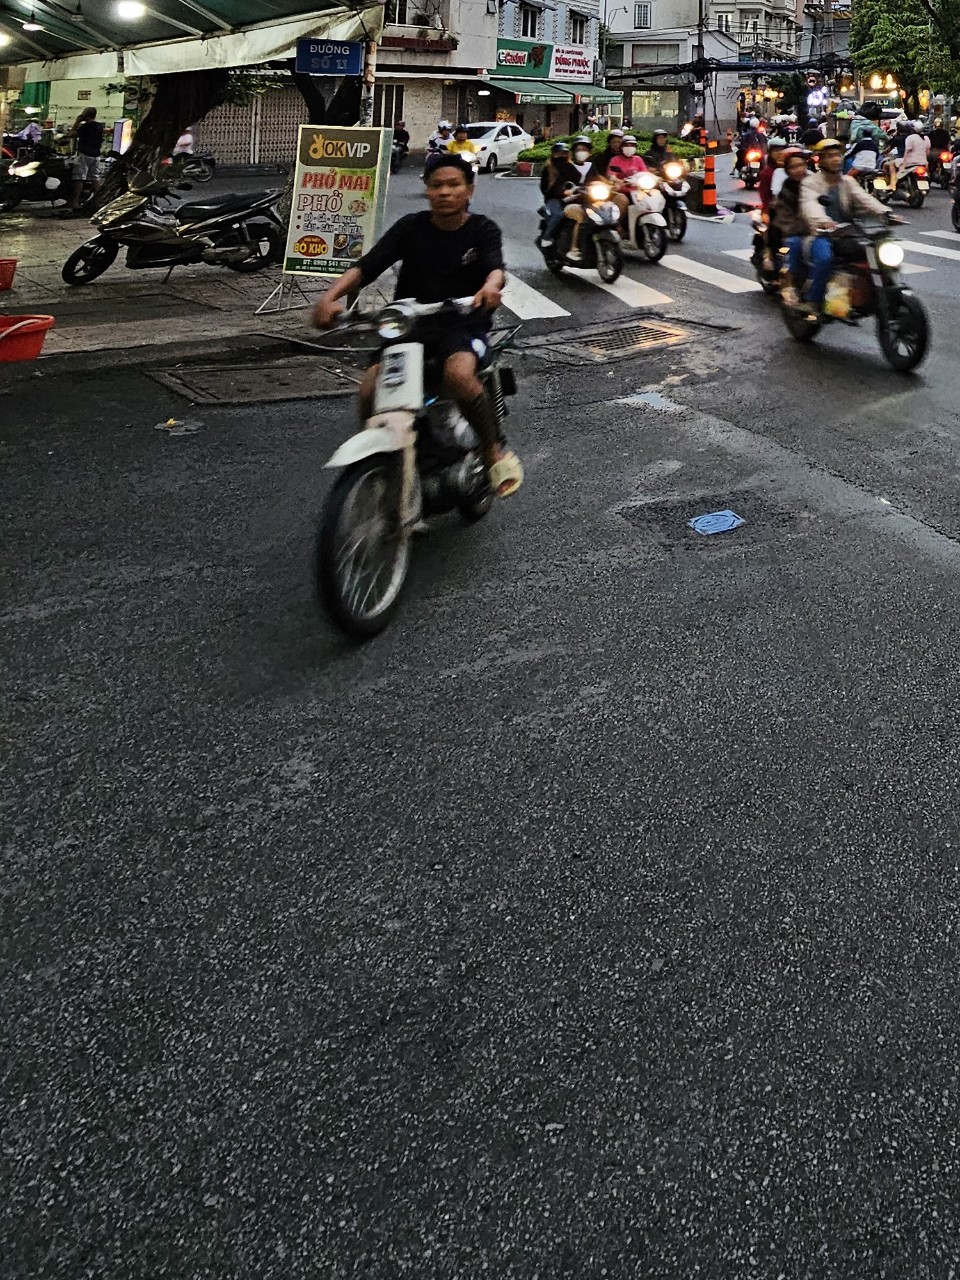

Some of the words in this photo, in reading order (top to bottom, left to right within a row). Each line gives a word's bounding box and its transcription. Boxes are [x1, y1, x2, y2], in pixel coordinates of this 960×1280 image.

[310, 43, 350, 55] ĐƯỜNG
[311, 55, 332, 69] SỐ
[336, 59, 348, 69] 11
[301, 168, 337, 189] PHỞ
[338, 175, 372, 191] MAI
[297, 190, 343, 212] PHỞ
[293, 241, 306, 253] BÒ
[309, 243, 328, 254] KHO
